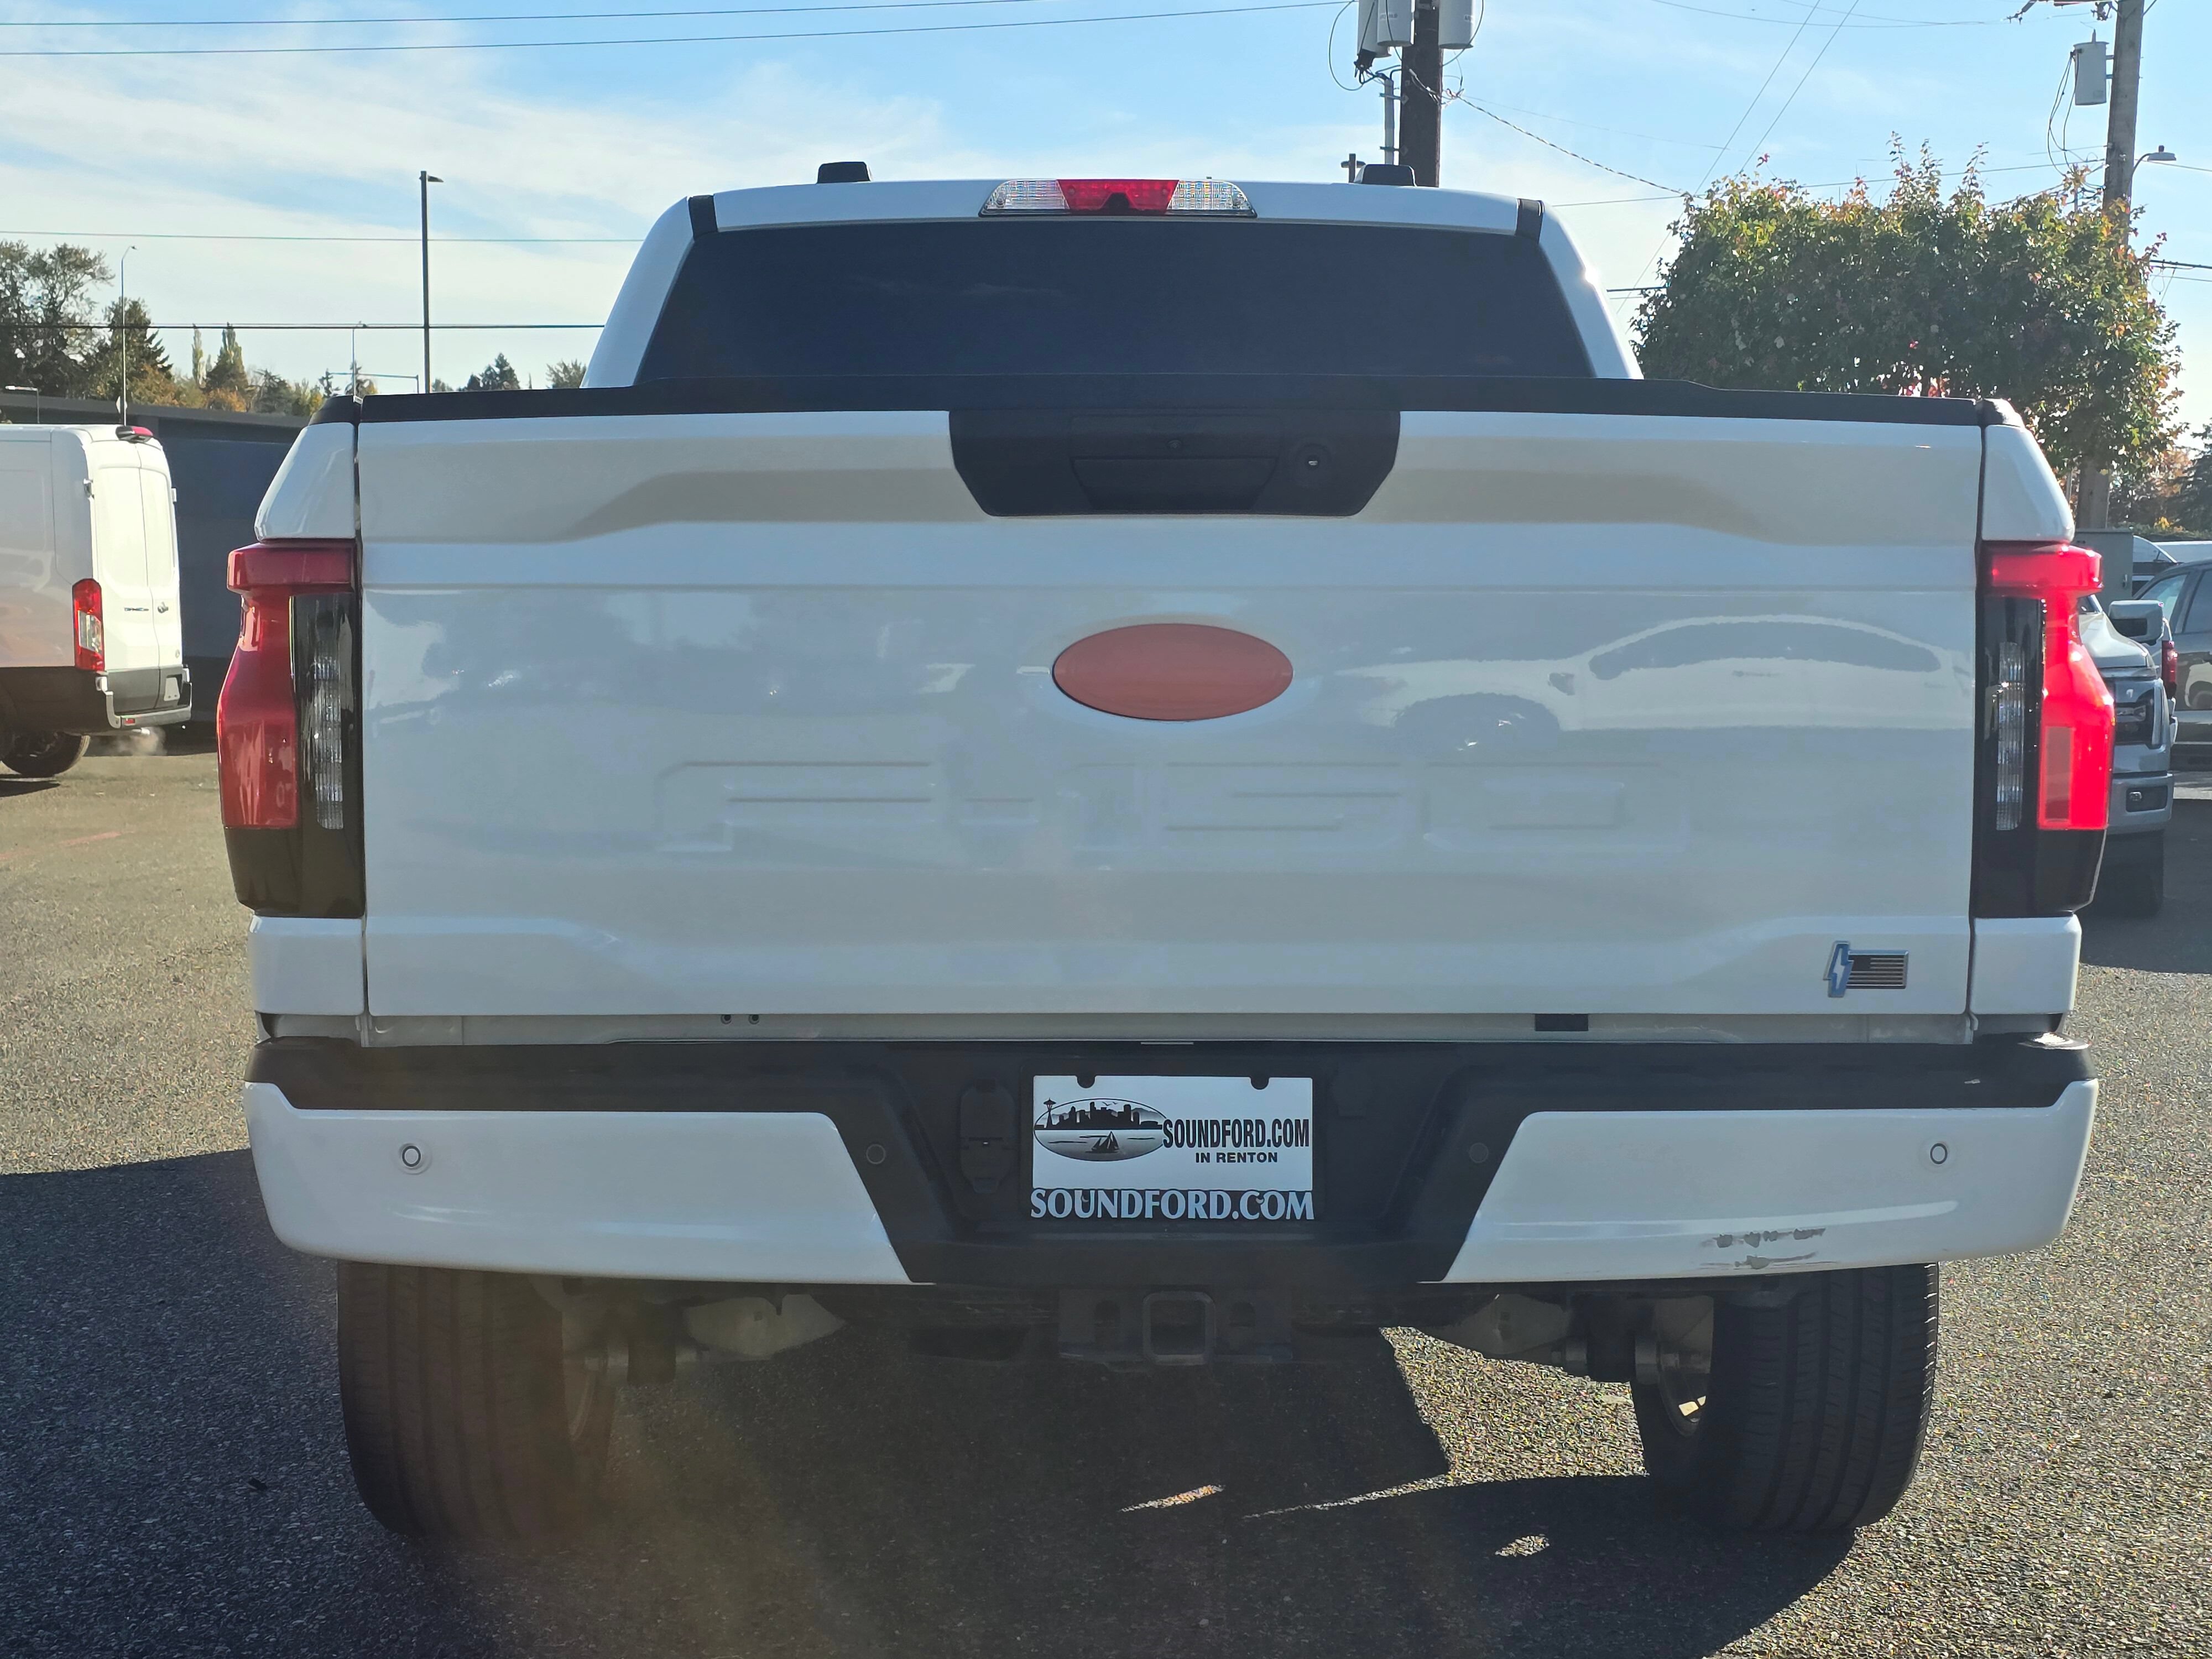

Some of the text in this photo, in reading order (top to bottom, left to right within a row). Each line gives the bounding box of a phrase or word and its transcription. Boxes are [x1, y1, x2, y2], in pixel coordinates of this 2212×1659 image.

[1163, 1119, 1310, 1148] SOUNDFORD.COM
[1196, 1152, 1277, 1163] IN RENTON
[1030, 1188, 1314, 1220] SOUNDFORD.COM
